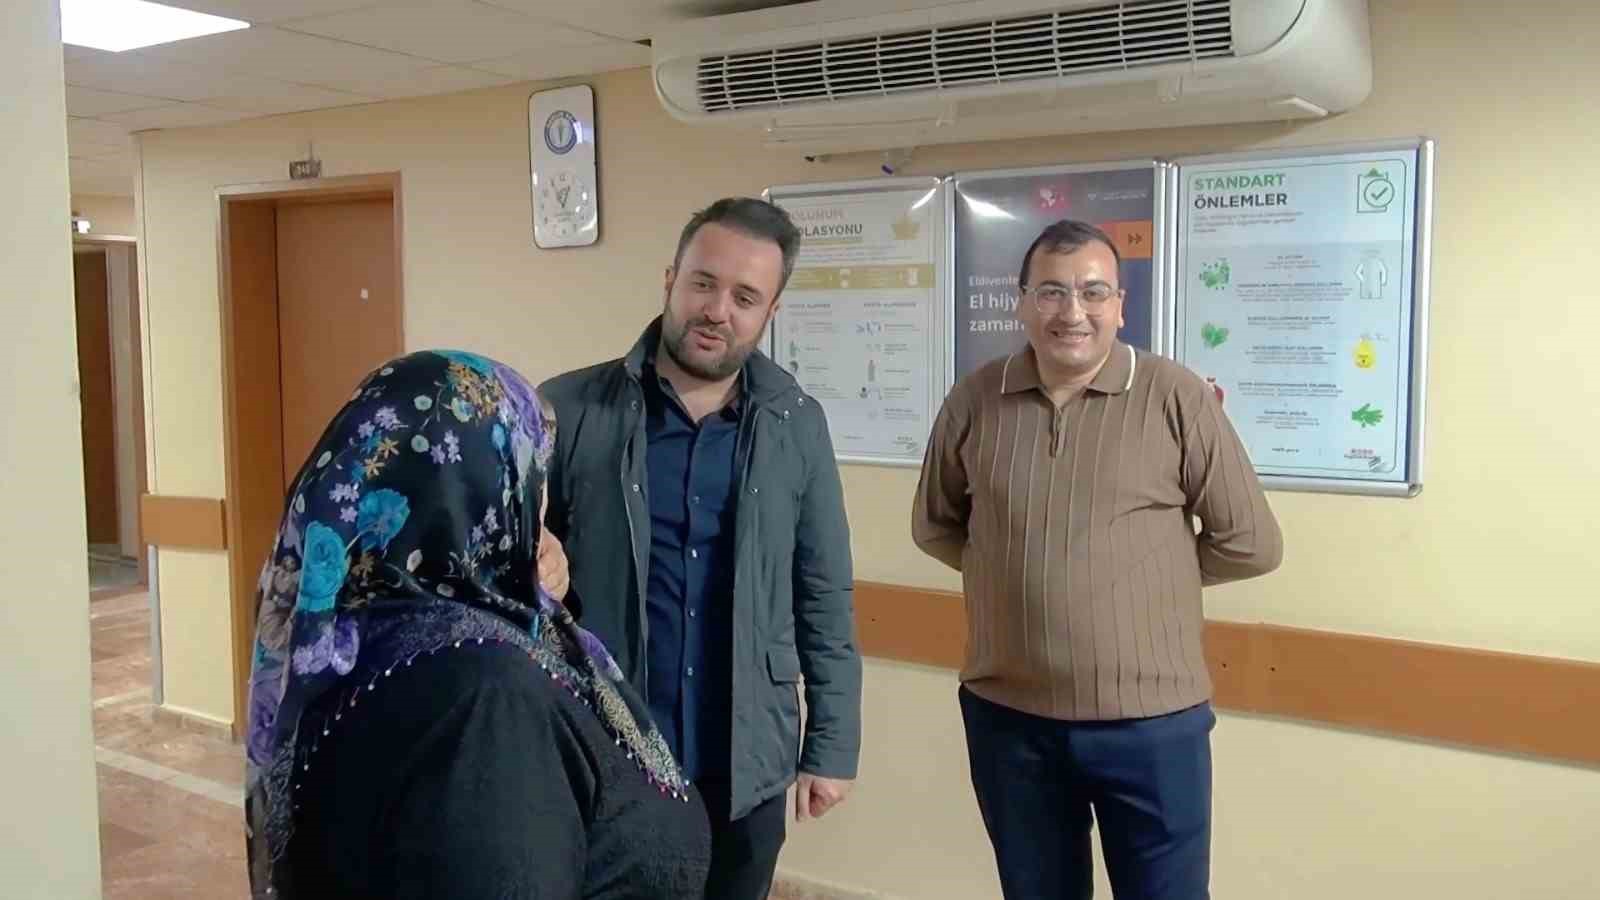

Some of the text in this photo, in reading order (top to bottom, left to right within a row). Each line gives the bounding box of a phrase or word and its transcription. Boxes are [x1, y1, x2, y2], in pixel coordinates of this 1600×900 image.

[1194, 174, 1286, 191] STANDART
[1194, 193, 1288, 209] ÖNLEMLER
[970, 294, 983, 309] El
